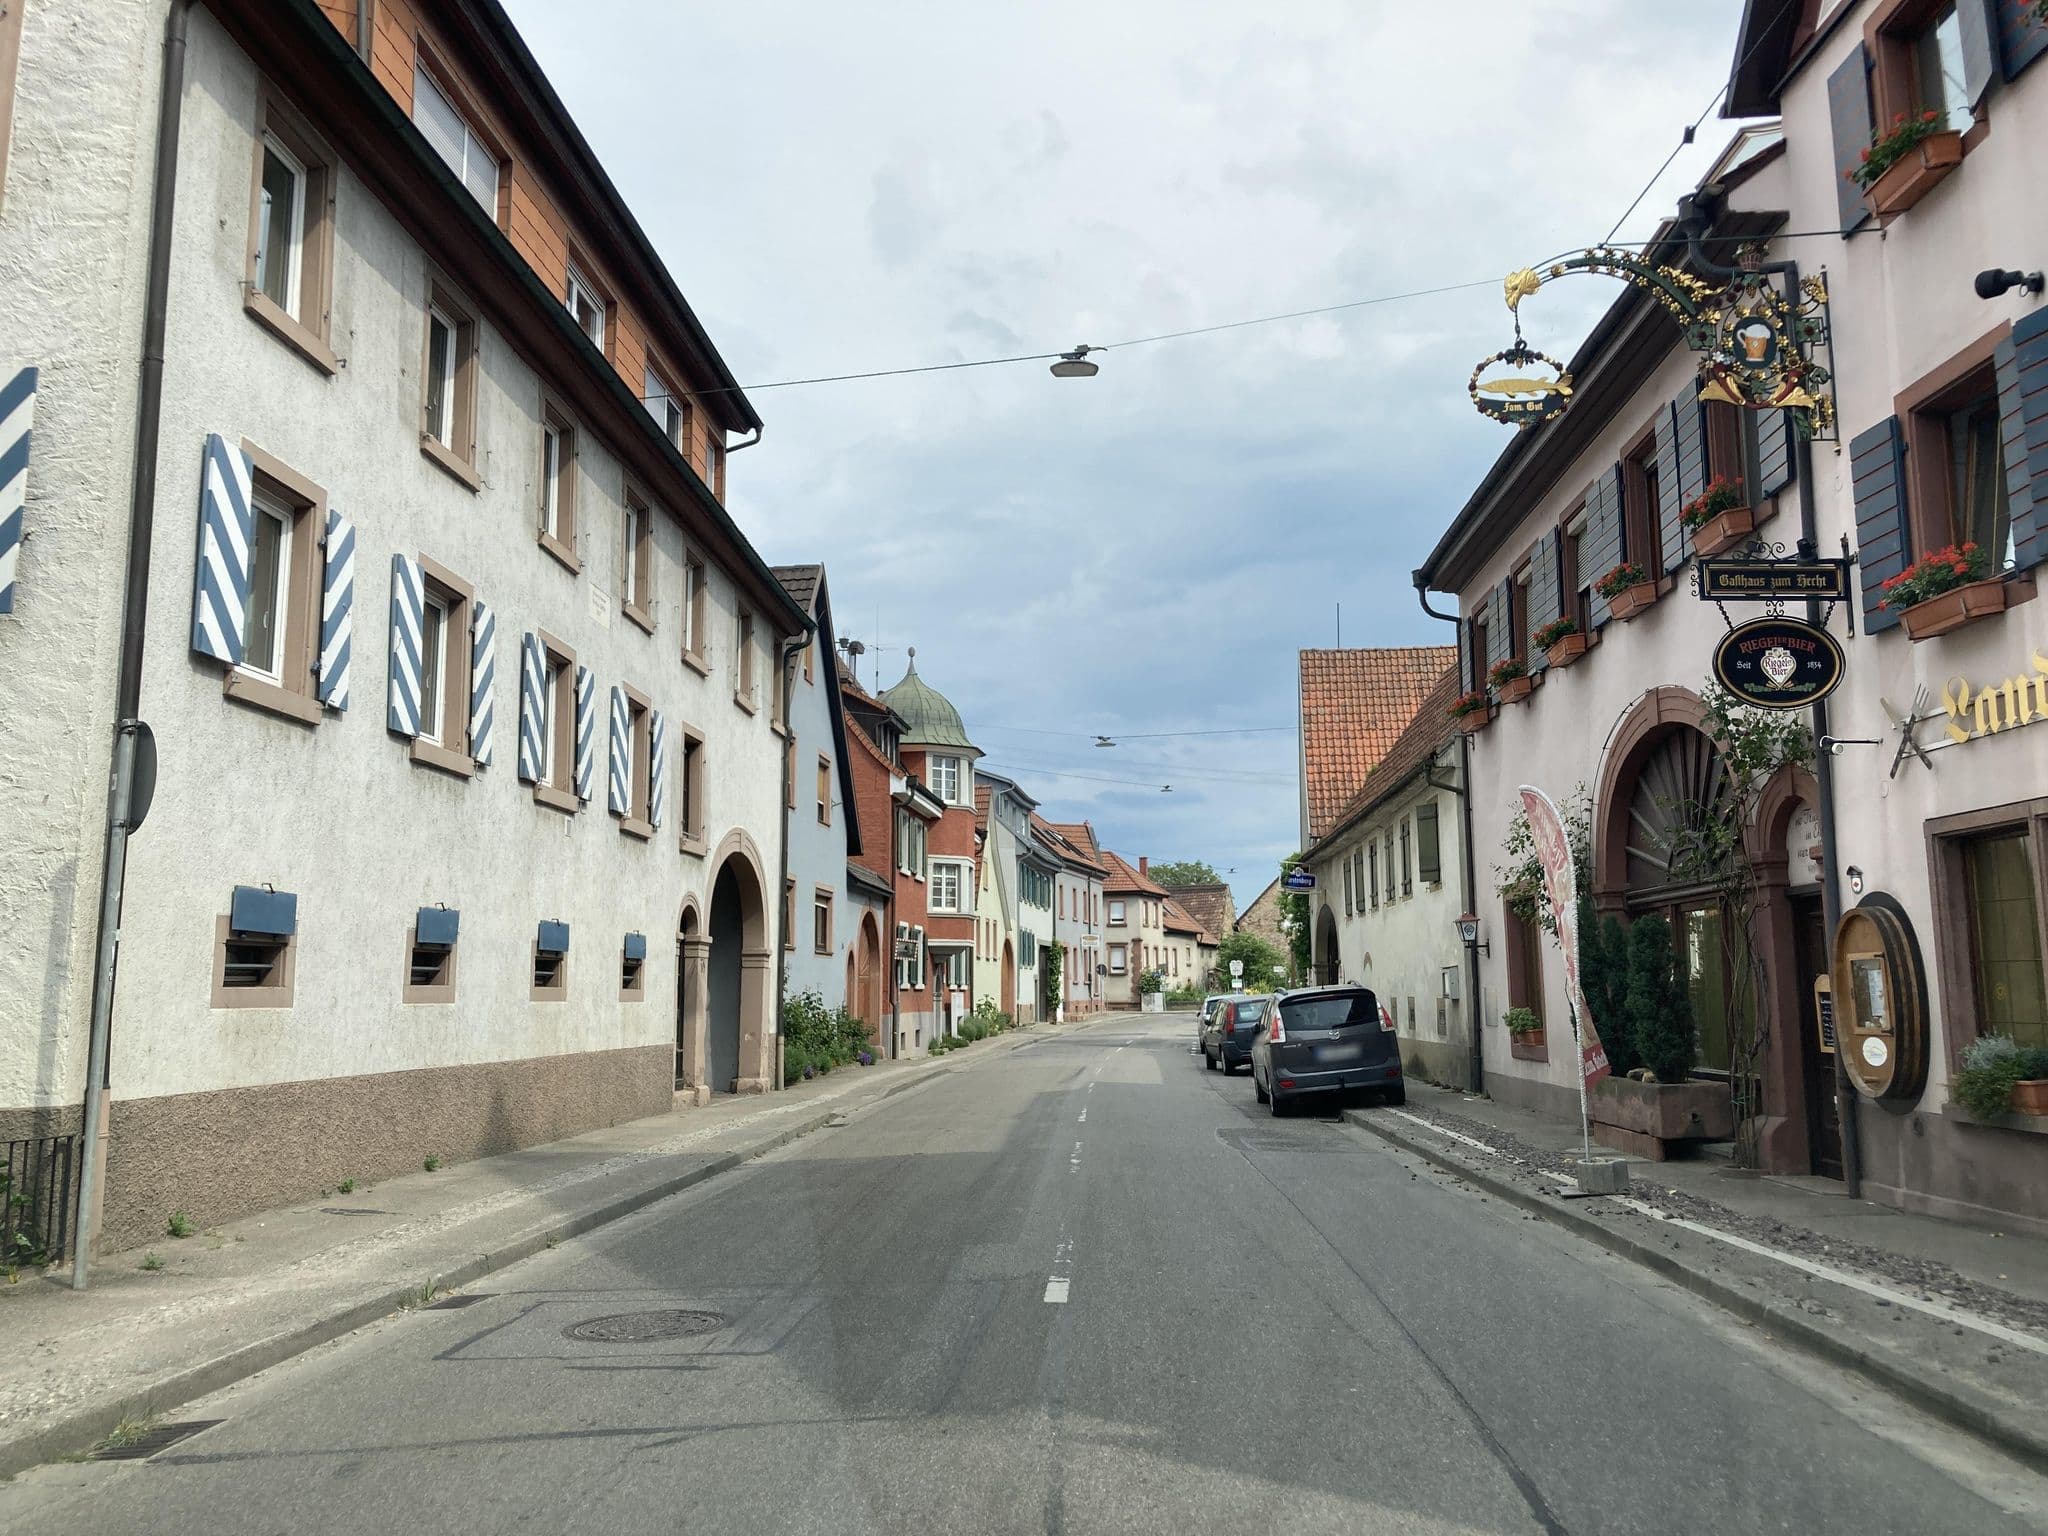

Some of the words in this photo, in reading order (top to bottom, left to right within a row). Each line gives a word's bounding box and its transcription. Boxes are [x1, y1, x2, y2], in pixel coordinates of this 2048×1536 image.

[1502, 402, 1524, 412] Fam.
[1526, 401, 1543, 411] Gut
[1770, 578, 1791, 588] zum
[1796, 574, 1827, 588] Hecht
[1788, 637, 1816, 654] BIER
[1736, 660, 1751, 669] Seit
[1770, 667, 1788, 676] Bier
